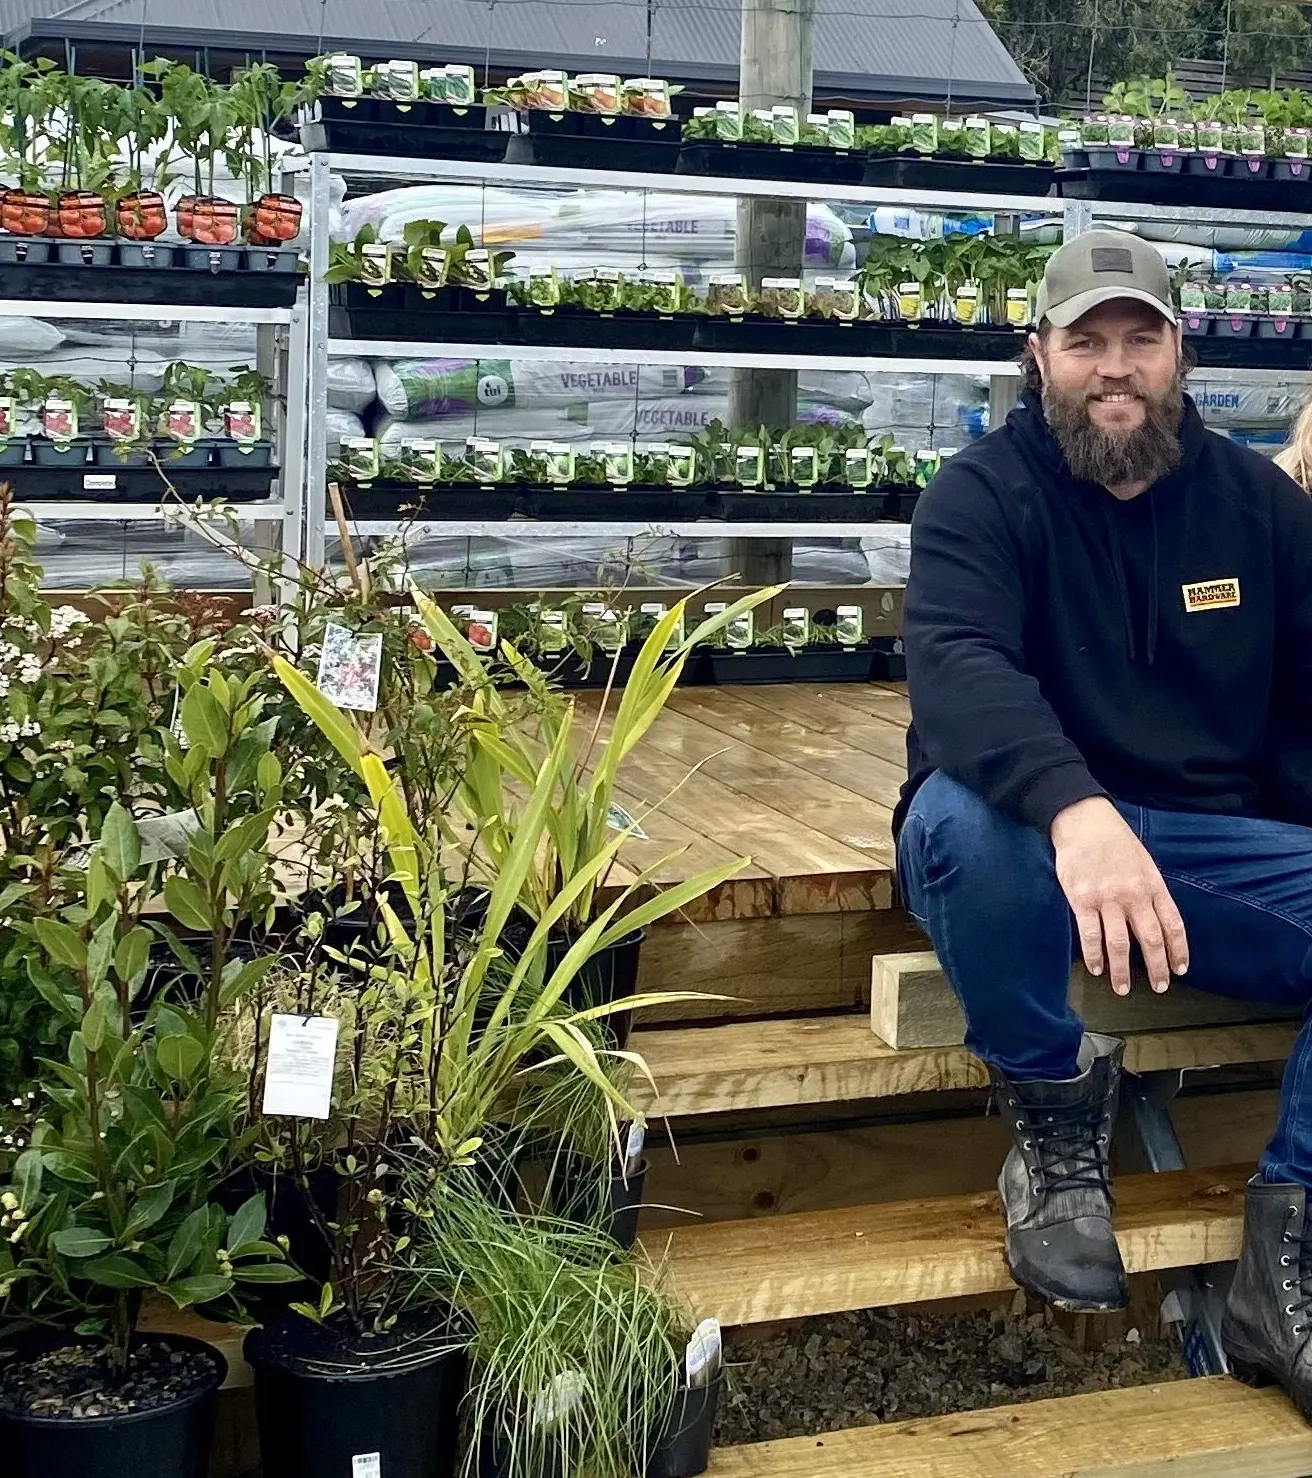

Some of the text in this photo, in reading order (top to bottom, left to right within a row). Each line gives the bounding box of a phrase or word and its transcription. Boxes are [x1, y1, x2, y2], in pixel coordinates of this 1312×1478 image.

[627, 219, 699, 234] ETABLE
[561, 371, 637, 388] VEGETABLE
[484, 384, 501, 397] tui
[1195, 393, 1240, 408] GARDEN
[1187, 583, 1236, 596] HAMMER
[1189, 592, 1237, 603] HARDWARE
